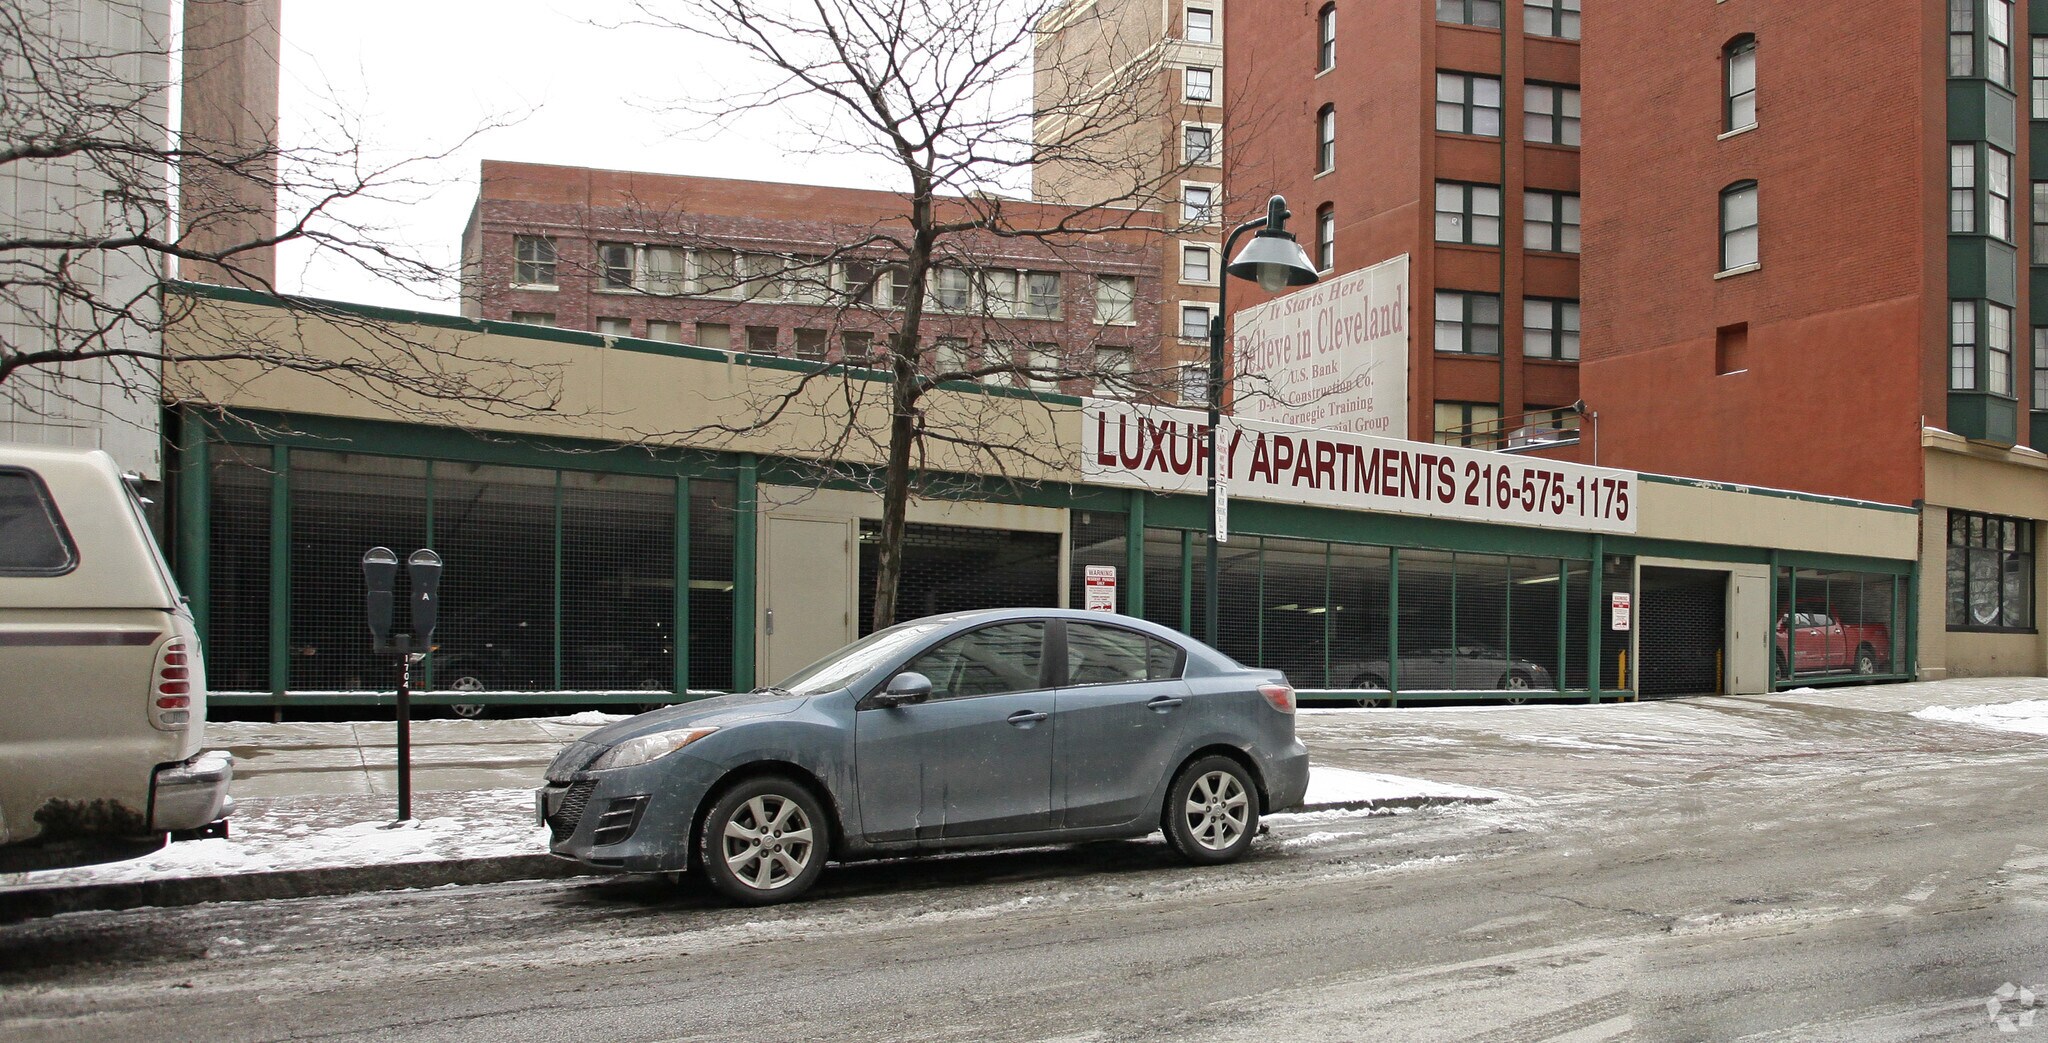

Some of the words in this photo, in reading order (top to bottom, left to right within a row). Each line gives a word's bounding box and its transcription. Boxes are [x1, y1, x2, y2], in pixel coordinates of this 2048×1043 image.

[1269, 303, 1281, 321] It
[1283, 291, 1324, 317] Starts
[1328, 278, 1365, 300] Here
[1238, 329, 1291, 375] Believe
[1296, 318, 1311, 361] in
[1317, 283, 1403, 354] Cleveland
[1290, 366, 1309, 385] U.S.
[1312, 359, 1338, 379] Bank
[1288, 379, 1352, 405] Construction
[1356, 373, 1374, 389] Co.
[1282, 405, 1325, 425] Carnegie
[1328, 396, 1374, 417] Training
[1355, 416, 1389, 432] Group
[1248, 431, 1456, 504] APARTMENTS
[1464, 460, 1629, 521] 216-575-1175
[422, 592, 430, 601] A
[402, 654, 410, 689] 1704
